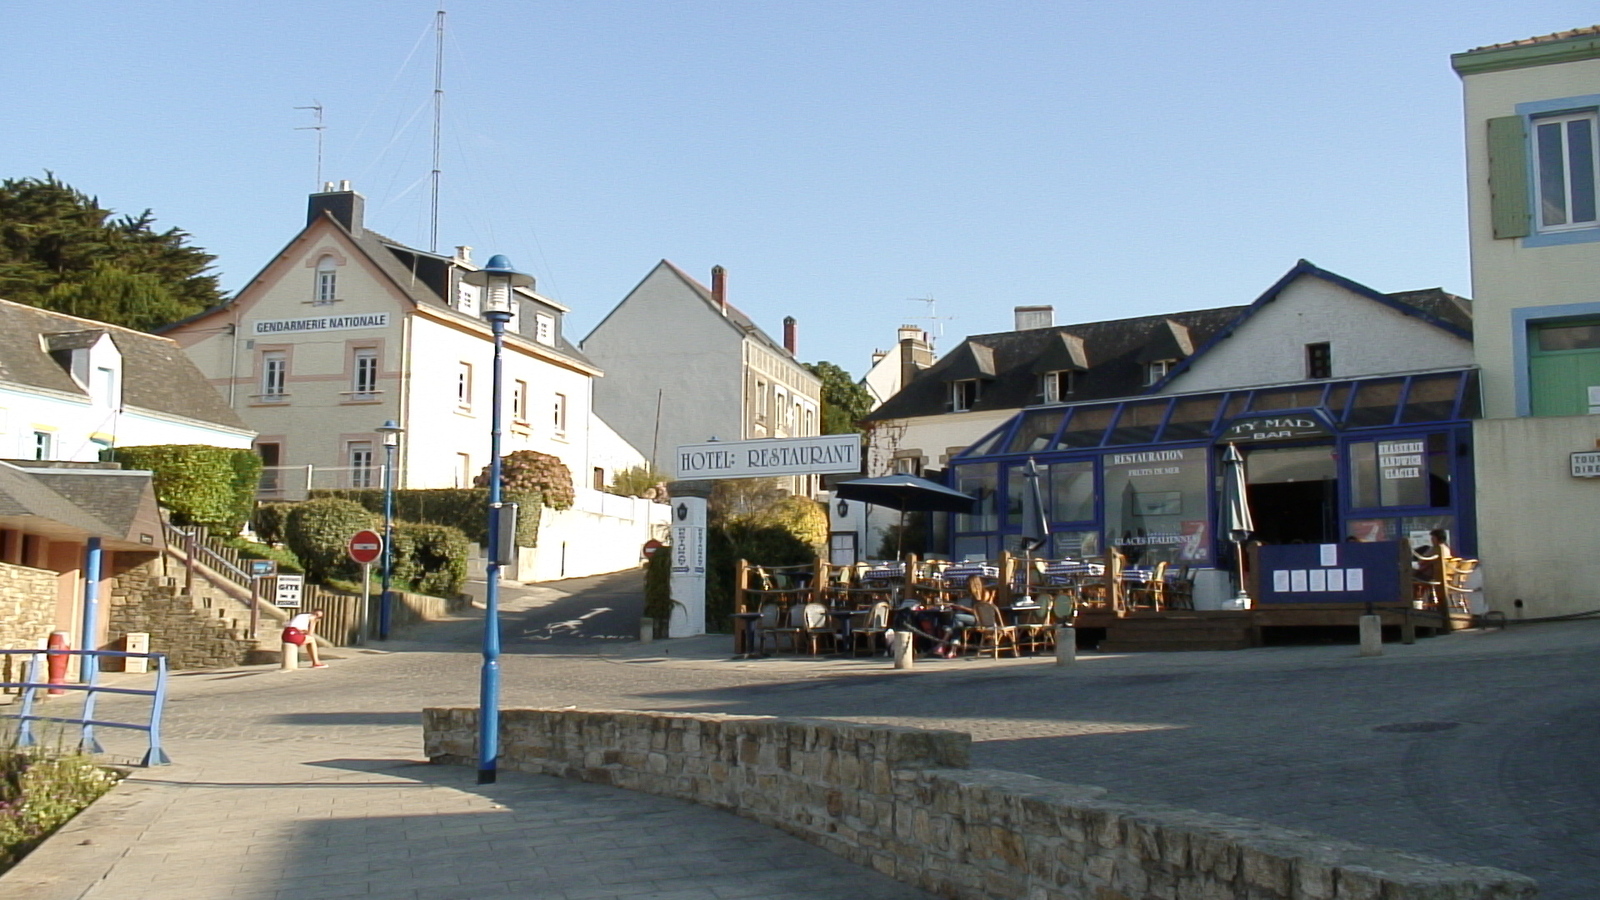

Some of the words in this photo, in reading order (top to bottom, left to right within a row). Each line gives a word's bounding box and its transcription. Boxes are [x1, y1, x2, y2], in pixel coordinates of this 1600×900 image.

[257, 318, 327, 333] GENDARMERIE
[329, 314, 386, 330] NATIONALE
[1265, 419, 1316, 428] MAD
[1253, 430, 1292, 440] BAR
[747, 445, 854, 468] RESTAURANT
[1114, 449, 1184, 465] RESTAURATION
[1165, 466, 1180, 474] MER
